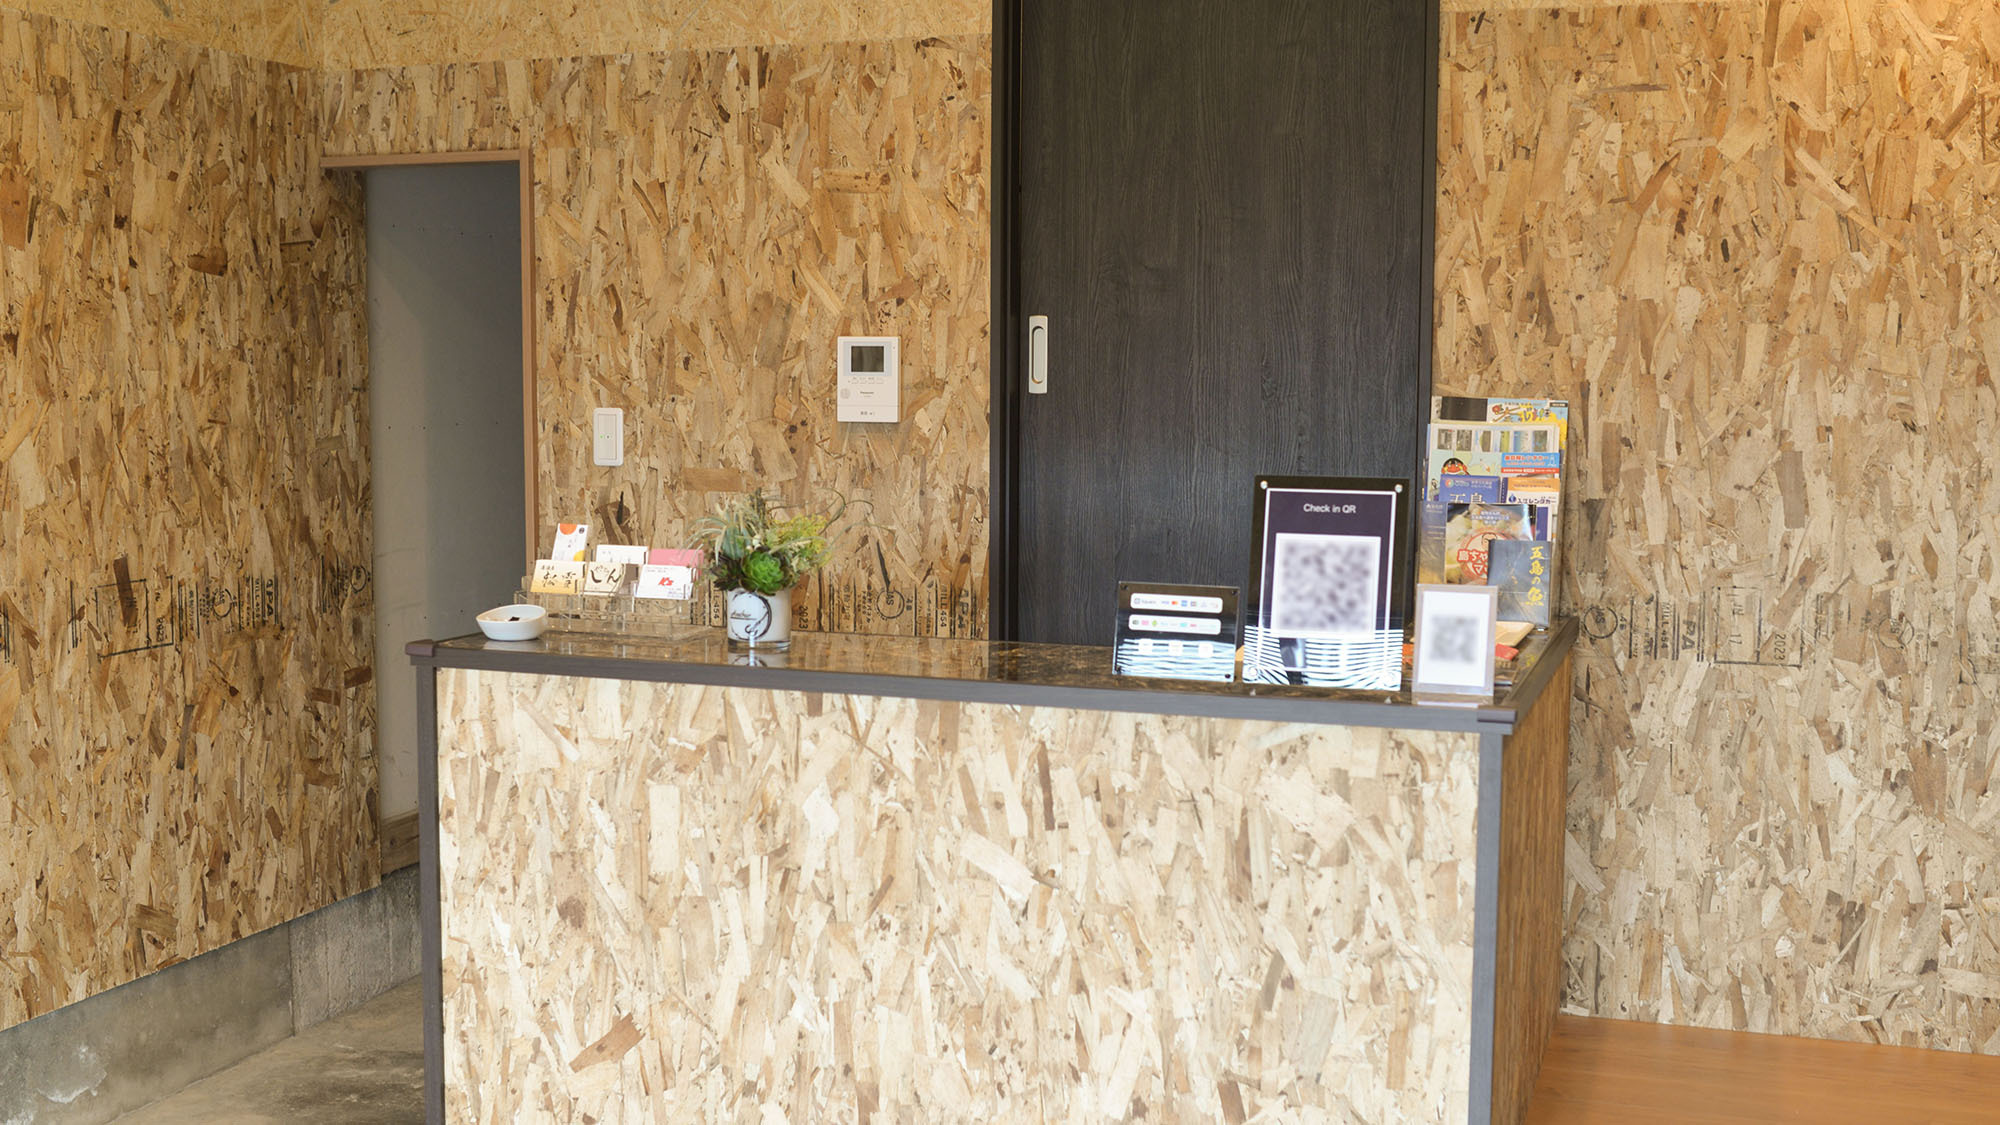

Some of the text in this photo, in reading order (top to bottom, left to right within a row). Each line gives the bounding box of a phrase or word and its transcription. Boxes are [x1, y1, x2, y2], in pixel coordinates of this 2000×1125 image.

[1303, 503, 1357, 514] Check in QR
[1525, 546, 1545, 606] 五島の魚
[800, 606, 809, 629] 2023
[1774, 633, 1787, 661] 2023
